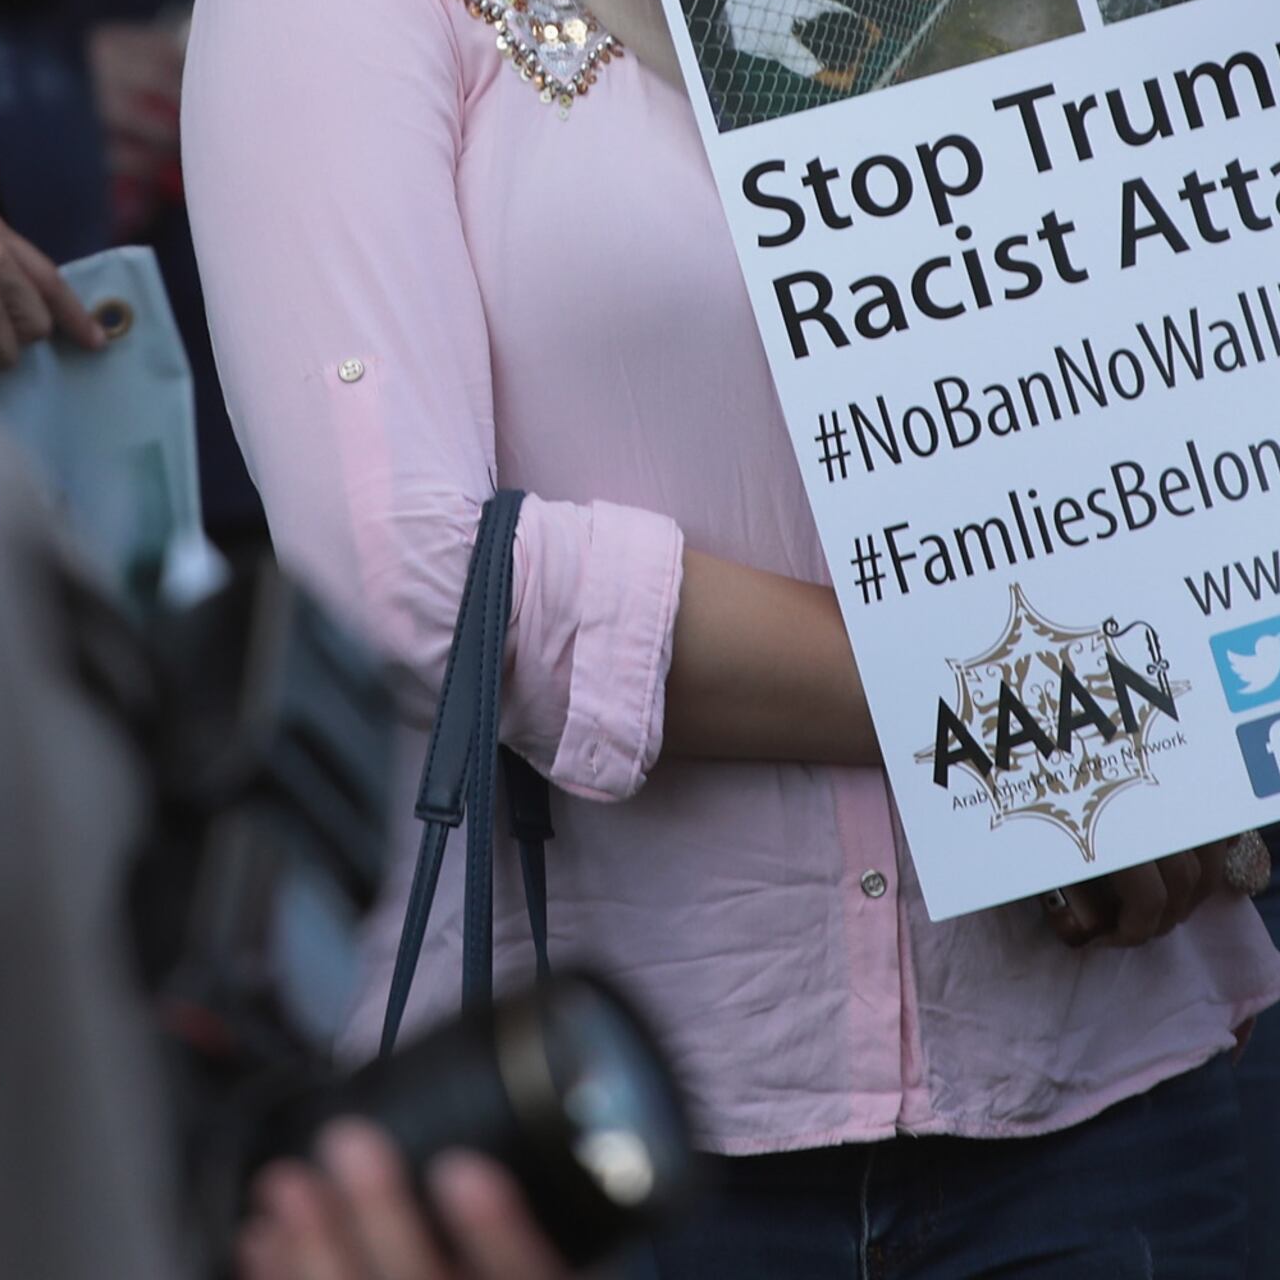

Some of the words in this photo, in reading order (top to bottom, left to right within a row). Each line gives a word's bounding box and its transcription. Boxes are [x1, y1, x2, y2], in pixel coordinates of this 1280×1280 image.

[740, 132, 984, 249] Stop
[771, 208, 1089, 361] Racist
[933, 651, 1180, 789] AAAN
[952, 789, 988, 811] Arab
[992, 768, 1066, 801] American
[1120, 730, 1188, 763] Network
